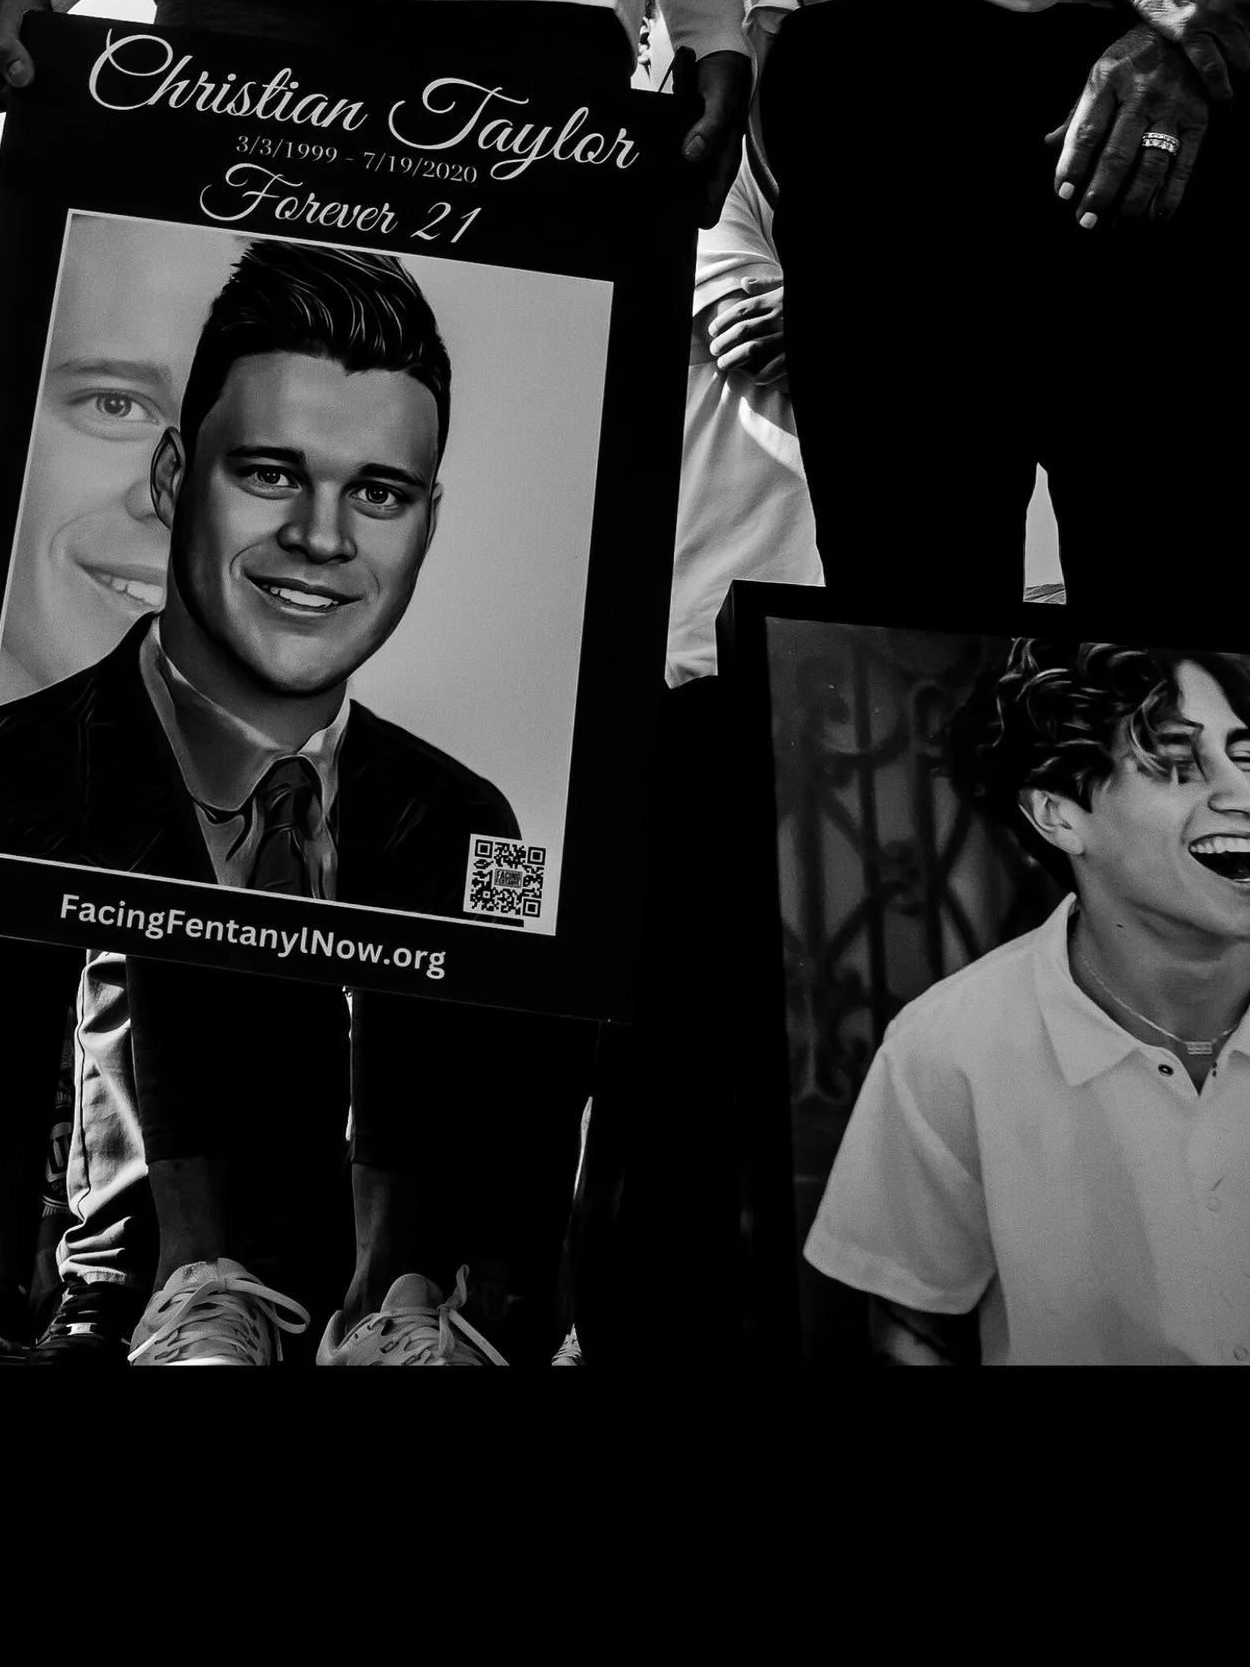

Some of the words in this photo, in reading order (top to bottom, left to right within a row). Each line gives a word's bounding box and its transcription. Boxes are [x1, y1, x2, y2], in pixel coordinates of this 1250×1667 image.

[88, 29, 367, 130] Christian
[389, 78, 639, 180] Taylor
[236, 135, 338, 164] 3/3/1999
[363, 152, 478, 183] 7/19/2020
[200, 163, 398, 234] Forever
[411, 202, 481, 244] 21
[60, 893, 446, 980] FacingFentanylNow.org
